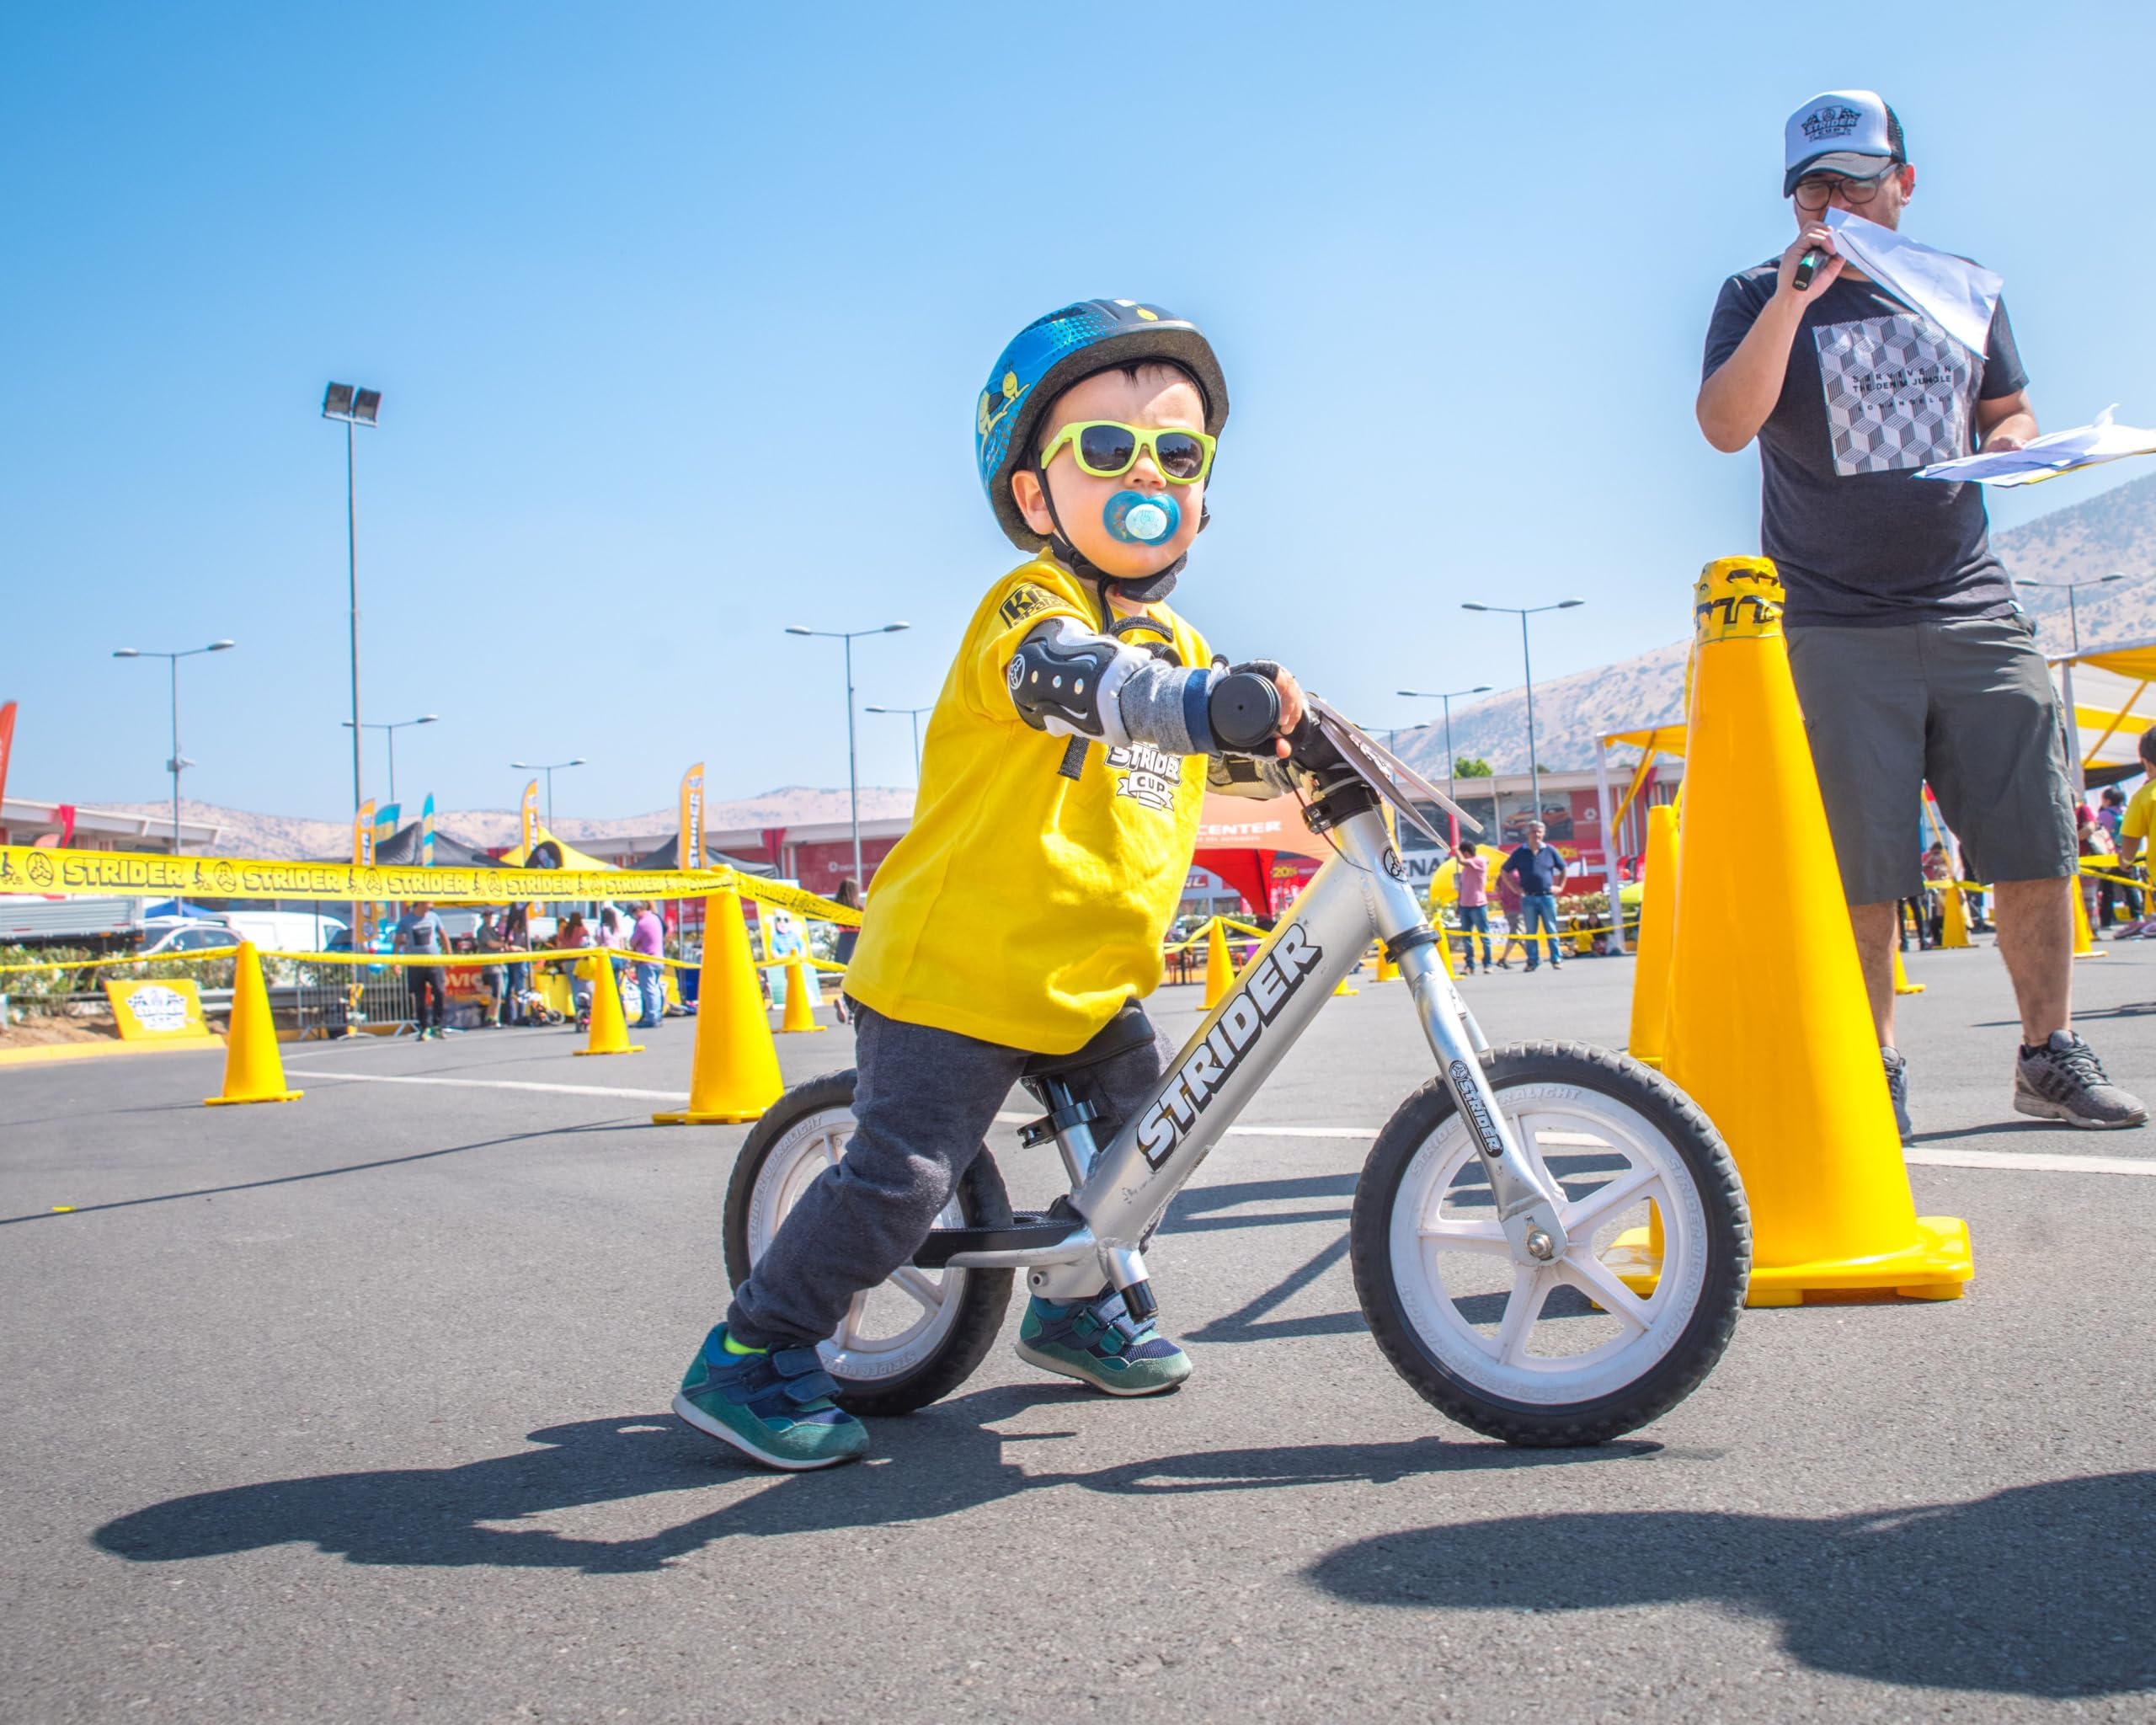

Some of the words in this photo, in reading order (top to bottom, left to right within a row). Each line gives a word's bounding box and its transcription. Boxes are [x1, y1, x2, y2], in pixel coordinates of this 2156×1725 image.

[1806, 115, 1858, 136] STRIDER
[1136, 776, 1166, 793] CUP
[64, 857, 186, 888] STRIDER
[243, 866, 342, 893] STRIDER
[387, 870, 468, 895] STRIDER
[505, 873, 574, 895] STRIDER
[606, 876, 662, 895] STRIDER
[1137, 924, 1322, 1172] STRIDER
[1457, 1079, 1502, 1152] STRIDER
